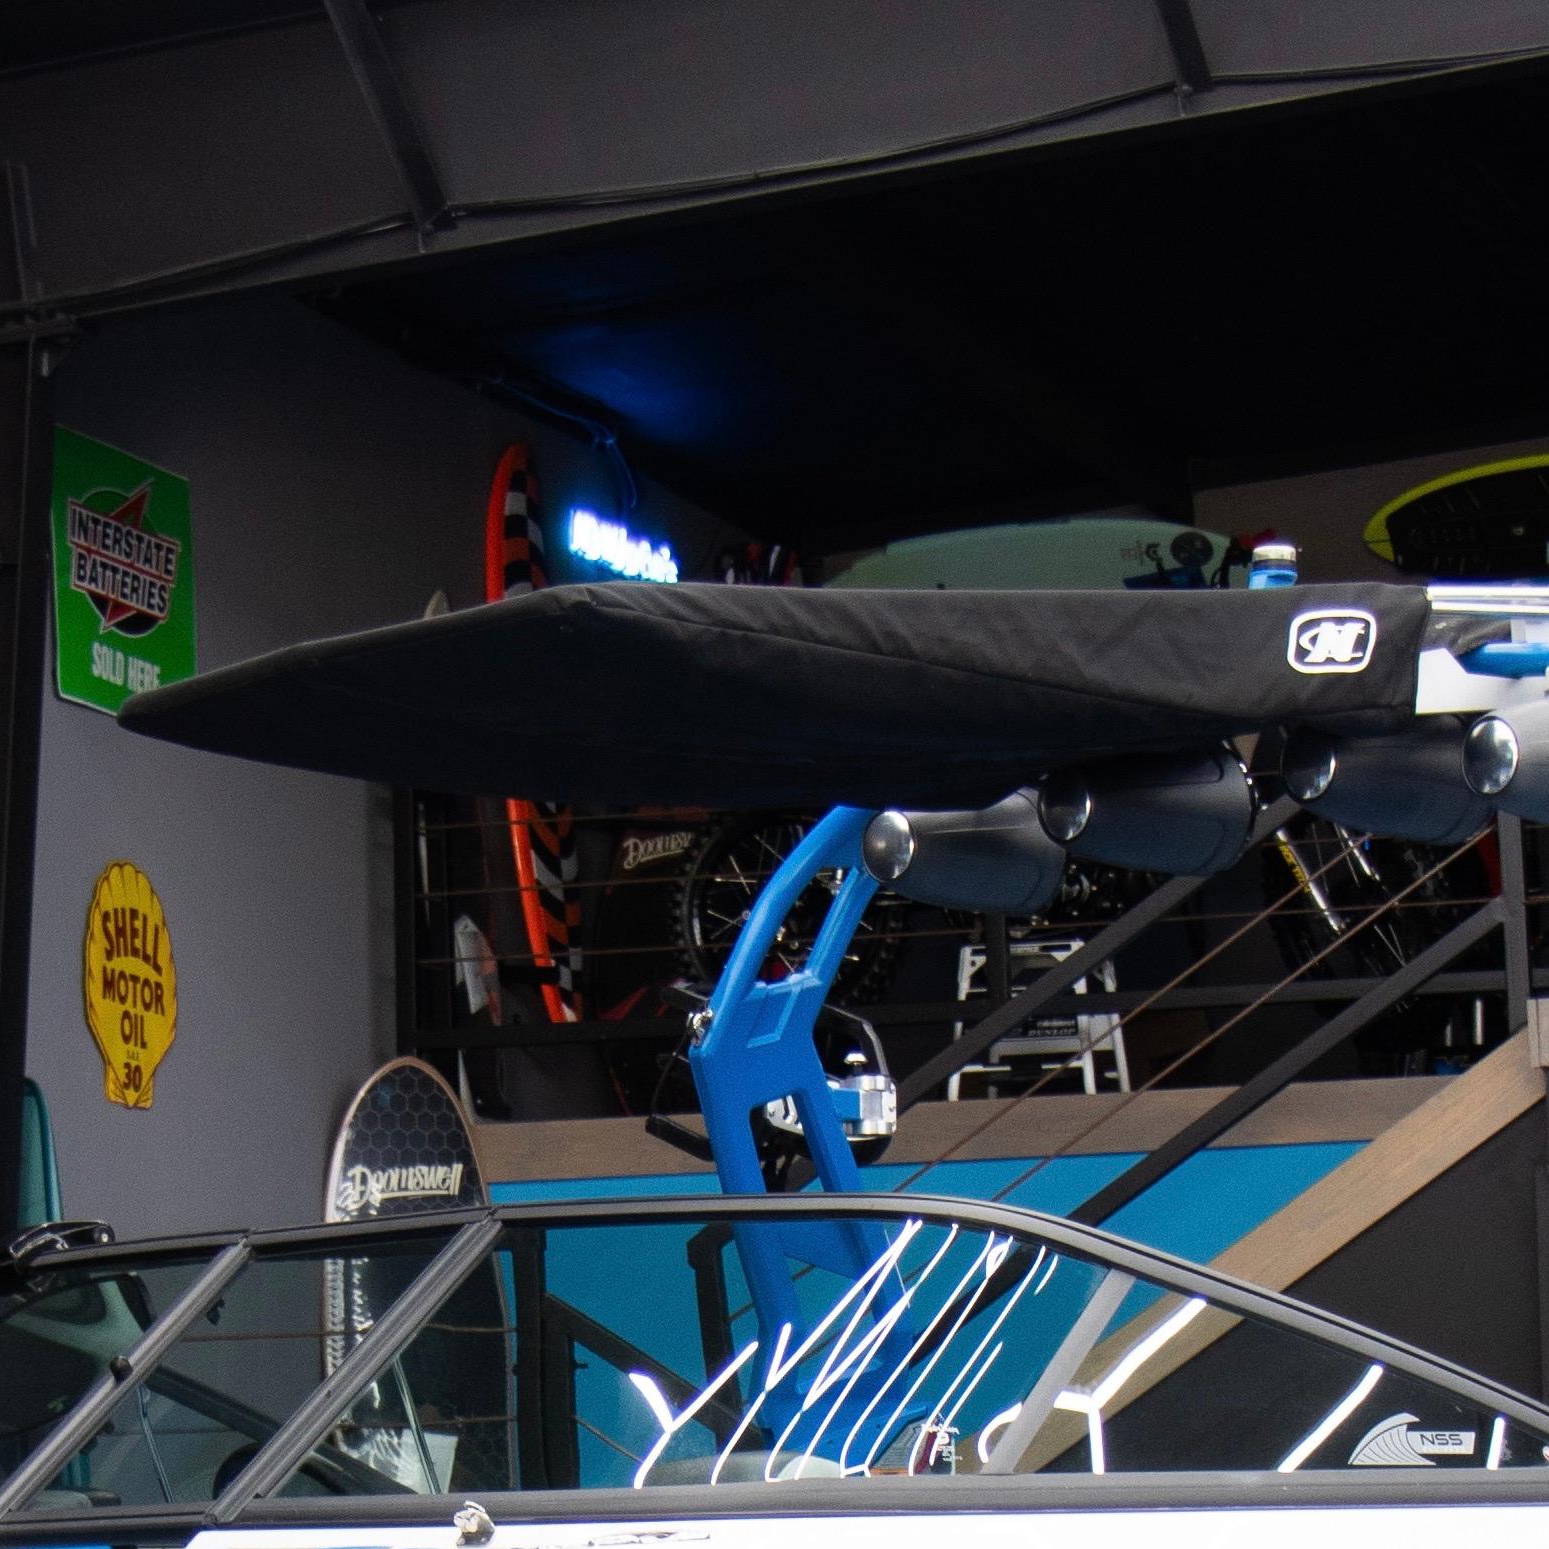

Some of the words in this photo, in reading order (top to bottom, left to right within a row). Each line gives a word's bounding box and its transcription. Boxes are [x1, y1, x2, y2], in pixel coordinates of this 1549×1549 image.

[70, 507, 177, 579] INTERSTATE
[75, 551, 169, 616] BATTERIES
[92, 640, 125, 687] SOLD
[127, 655, 161, 693] HERE
[101, 906, 164, 978] SHELL
[102, 964, 166, 1017] MOTOR
[119, 1009, 148, 1051] OIL
[122, 1061, 144, 1094] 30
[340, 1162, 465, 1211] Doomswell
[1419, 1433, 1464, 1447] NSS
